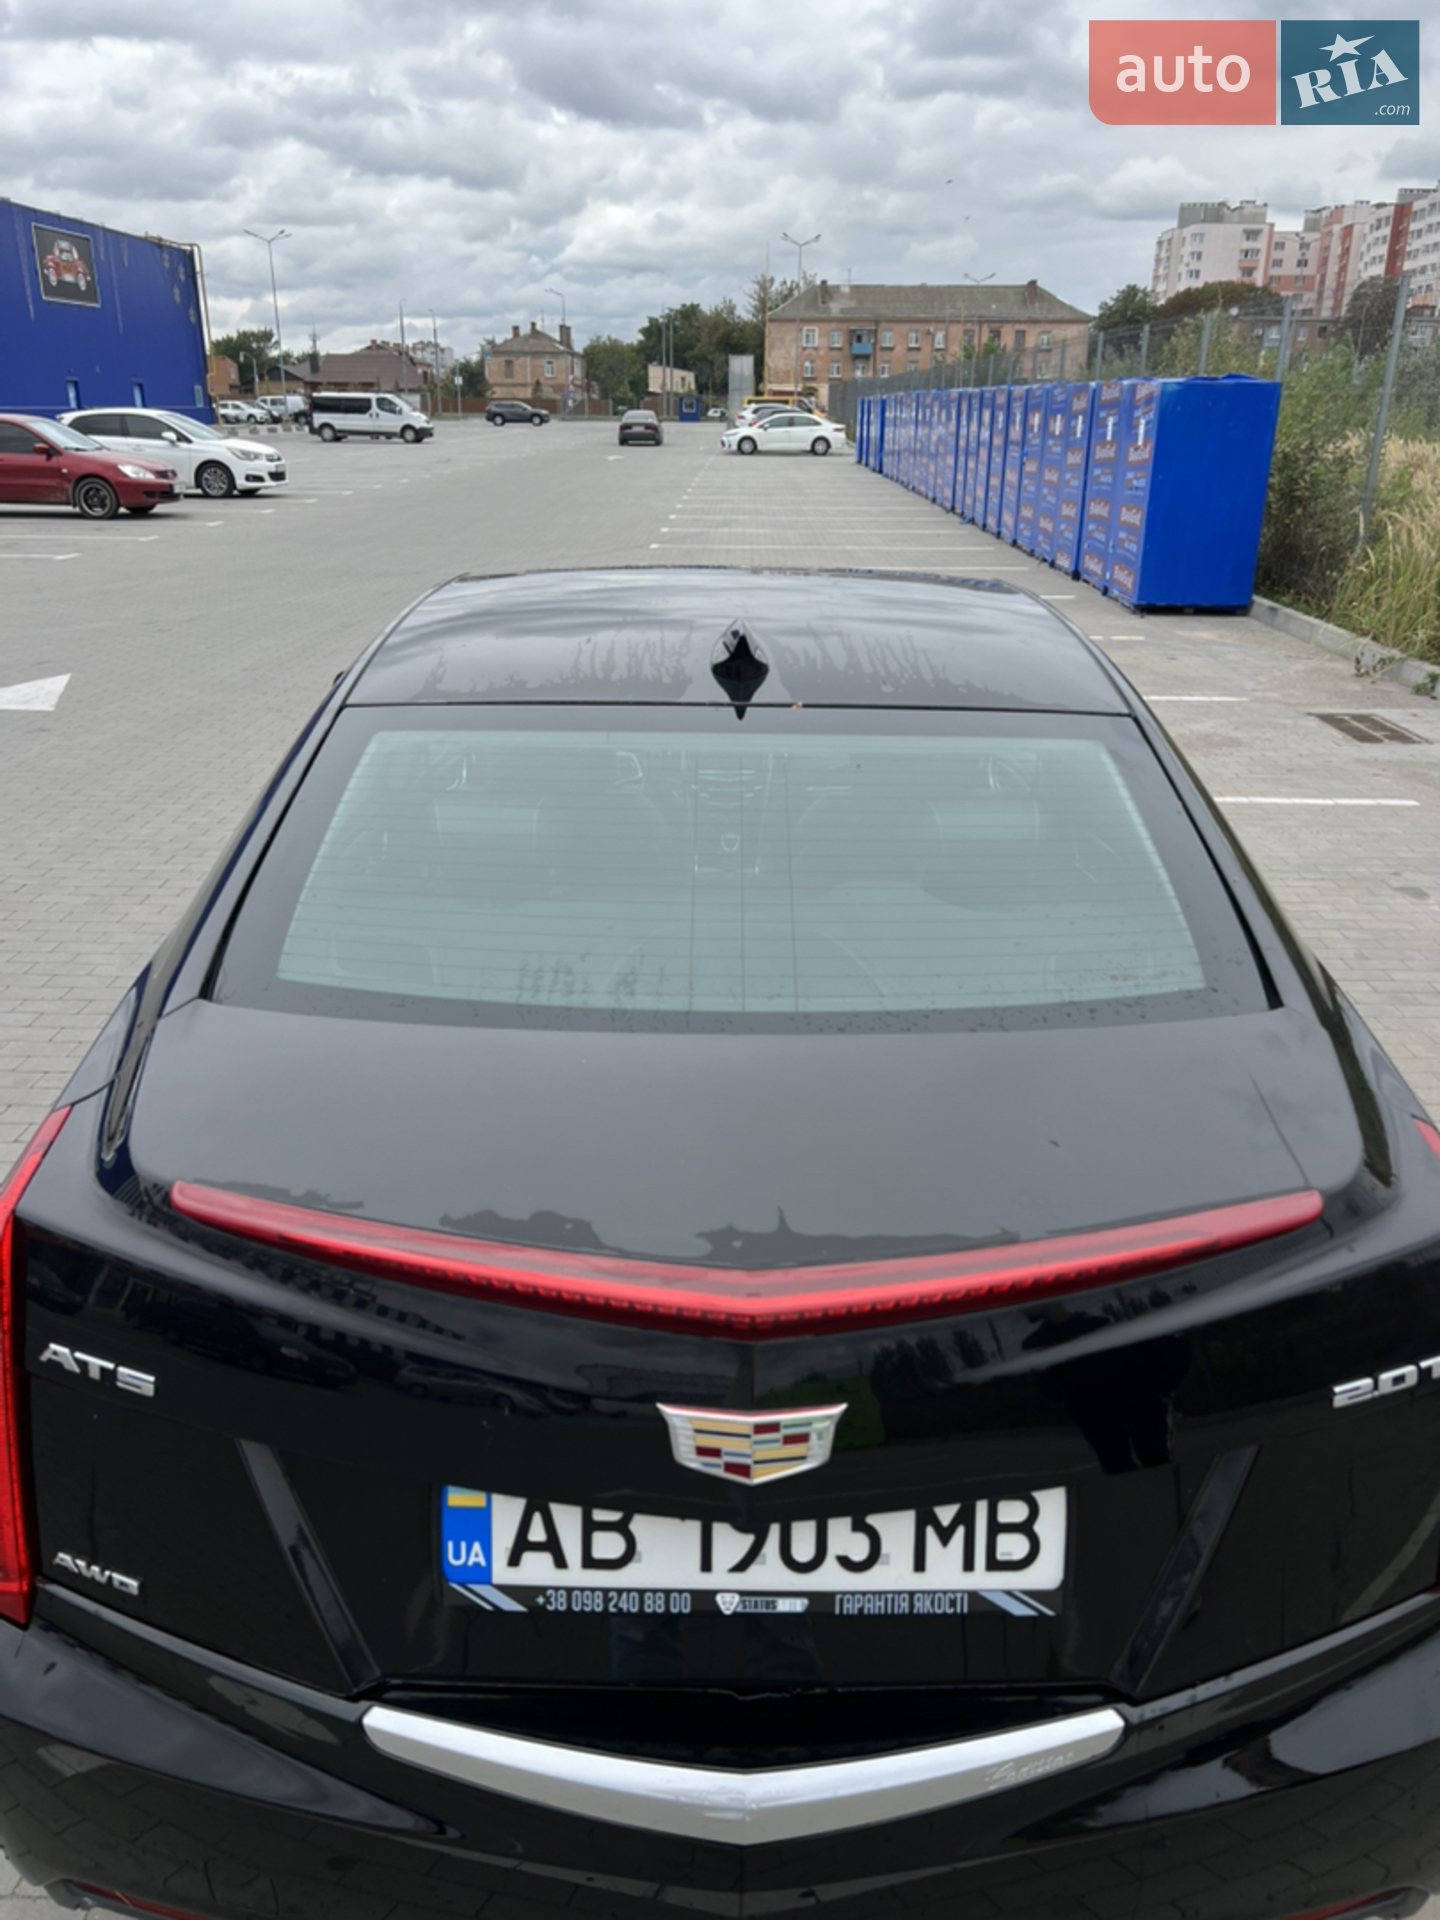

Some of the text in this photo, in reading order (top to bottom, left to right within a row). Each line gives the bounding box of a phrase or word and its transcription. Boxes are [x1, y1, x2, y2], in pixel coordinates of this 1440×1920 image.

[39, 1342, 156, 1398] ATS
[507, 1496, 638, 1570] AB
[913, 1490, 1041, 1573] MB
[447, 1540, 487, 1567] UA
[535, 1589, 692, 1614] +38 098 240 88 00
[834, 1592, 910, 1615] ГАРАНТІЯ
[913, 1592, 969, 1615] ЯКОСТІ
